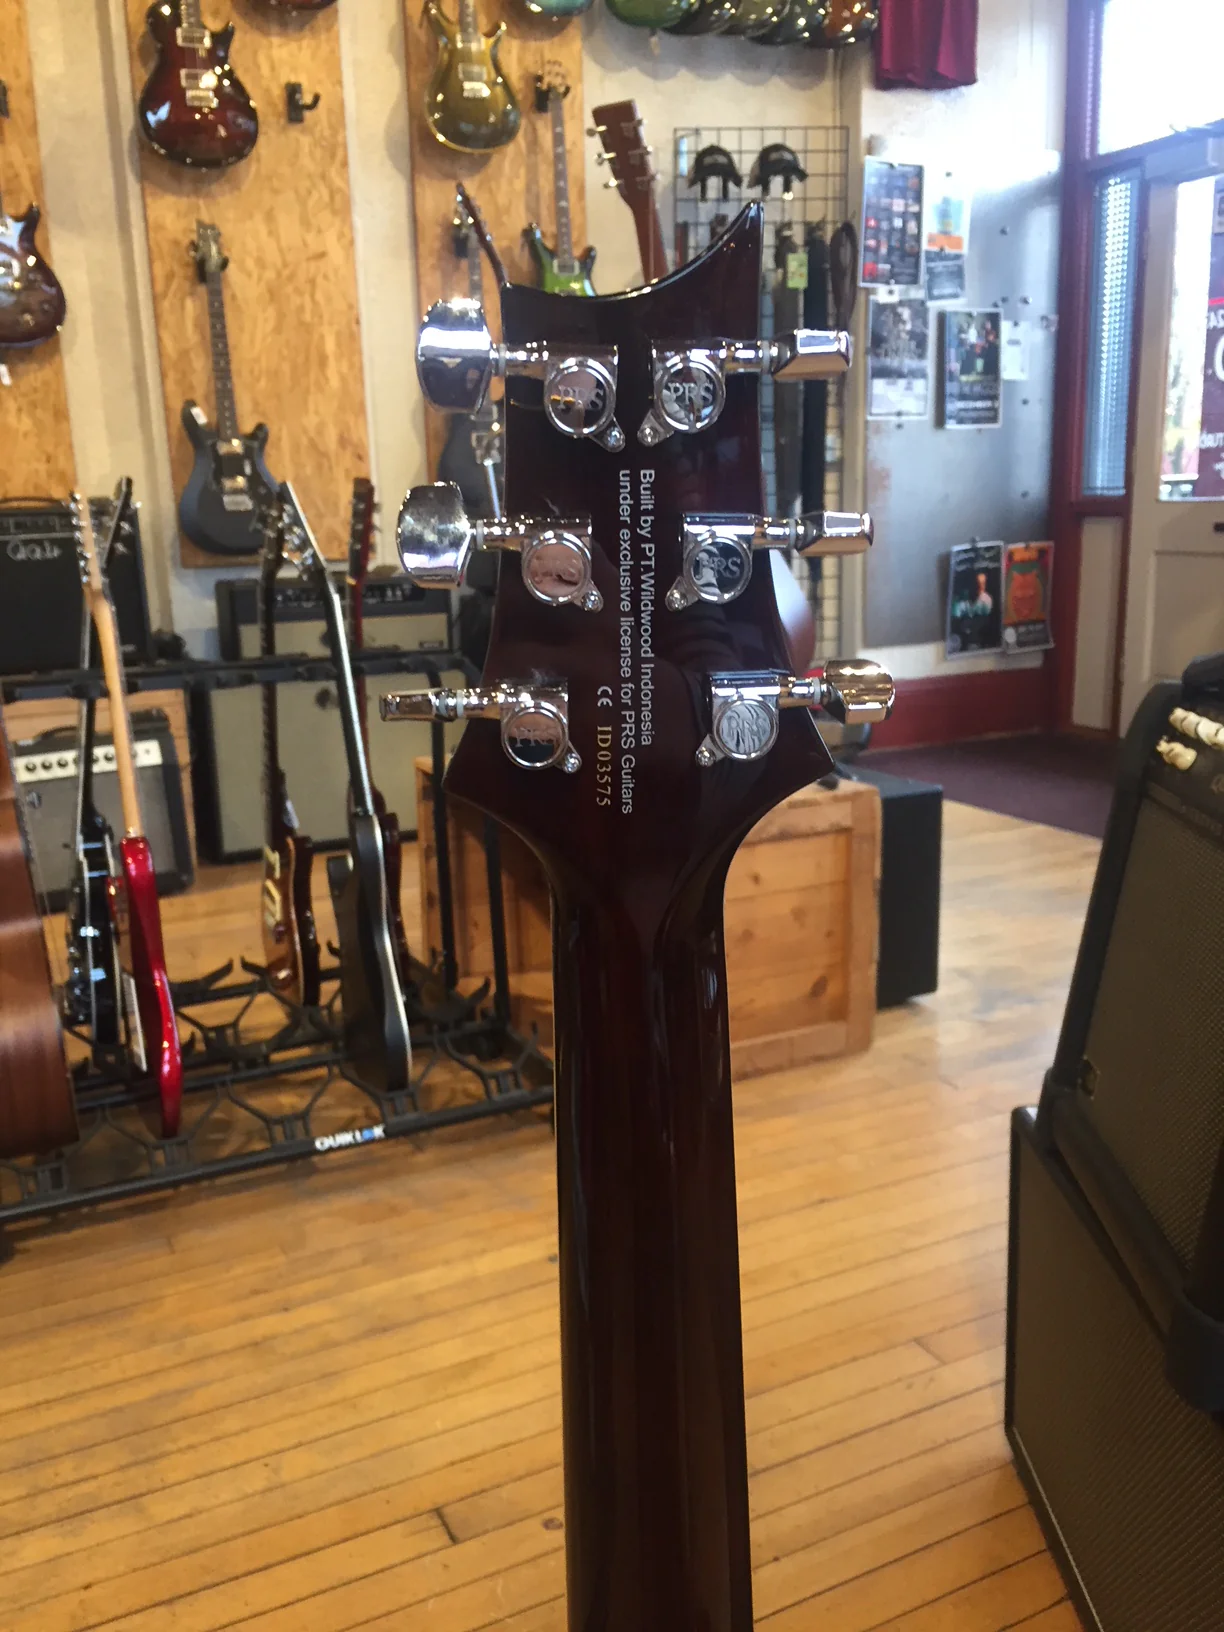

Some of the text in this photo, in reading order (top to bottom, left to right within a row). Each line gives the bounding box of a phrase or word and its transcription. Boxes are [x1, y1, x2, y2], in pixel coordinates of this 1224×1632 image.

[668, 381, 713, 405] PRS
[619, 470, 636, 814] under exclusive license for PRS Guitars
[637, 469, 655, 745] Built by PT.Wildwood Indonesia
[596, 725, 612, 806] ID03575
